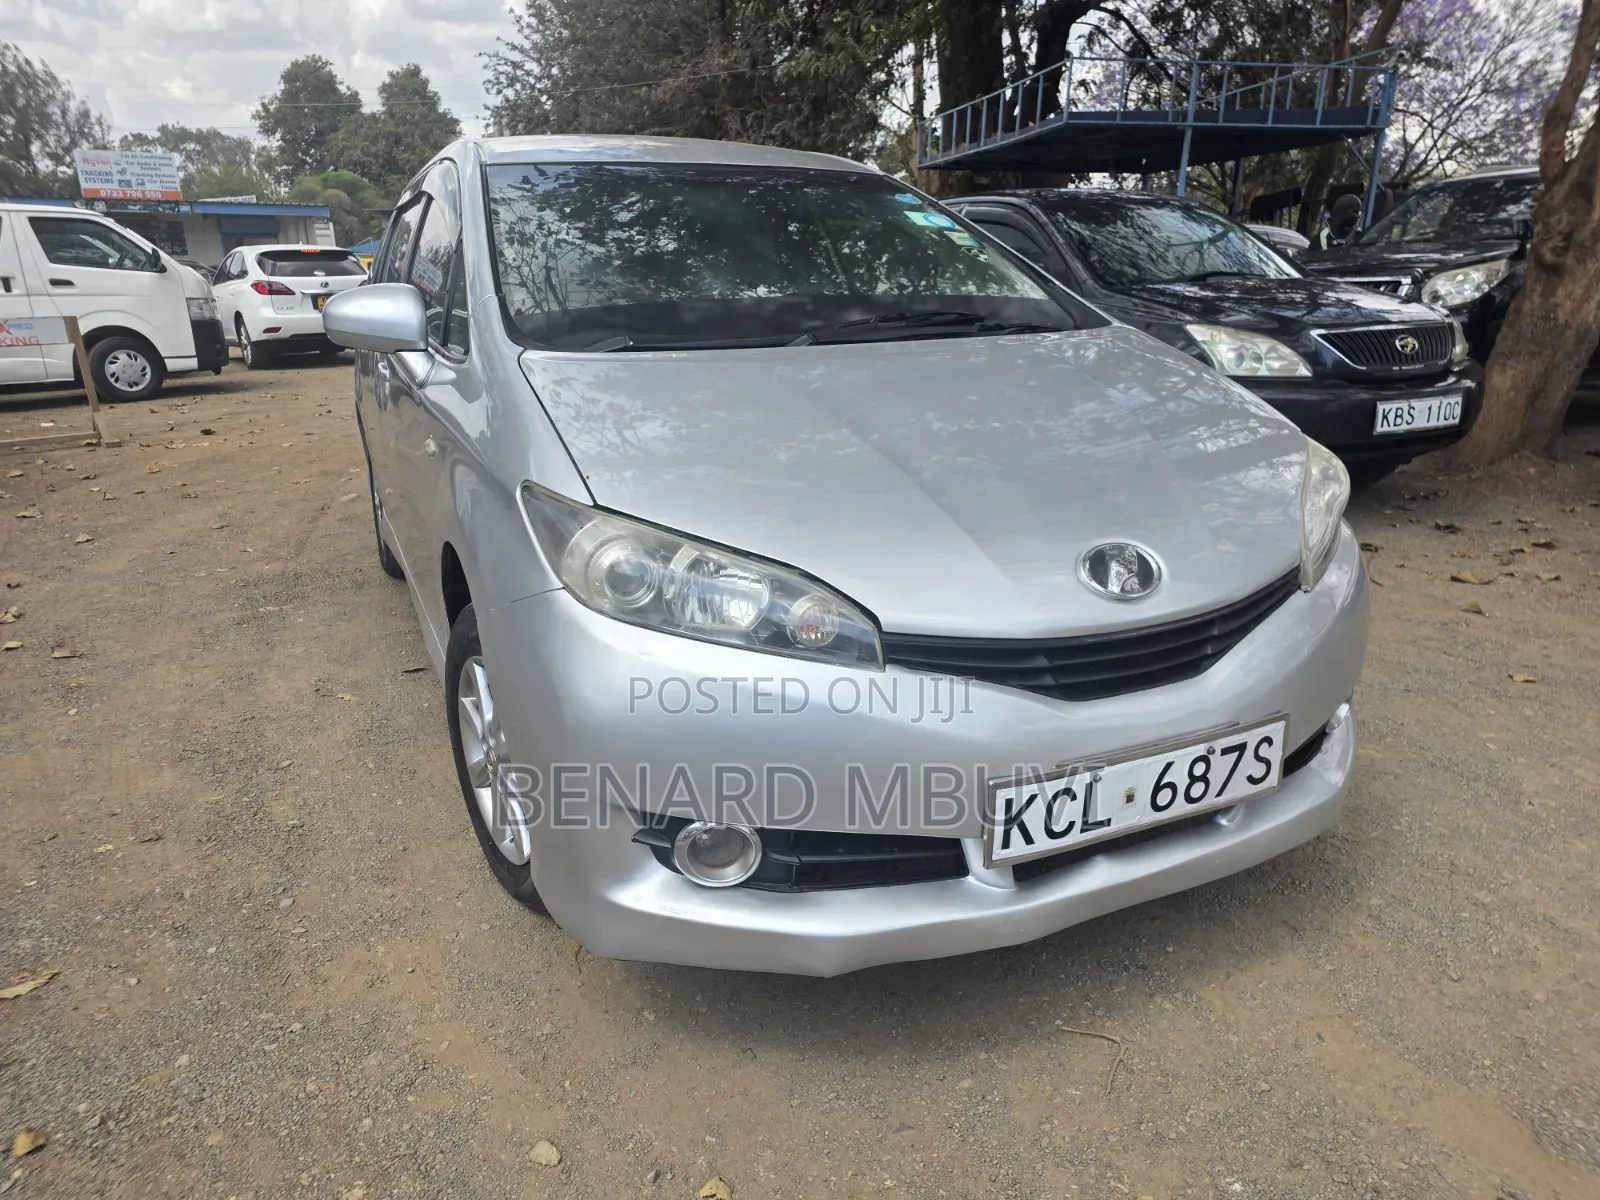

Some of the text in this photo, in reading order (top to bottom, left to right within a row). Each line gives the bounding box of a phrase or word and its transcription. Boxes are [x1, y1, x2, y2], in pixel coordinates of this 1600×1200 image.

[80, 169, 114, 177] TRACKING
[100, 189, 123, 198] 0723
[1380, 400, 1460, 429] KBS 110C
[1001, 735, 1275, 850] KCL 687S
